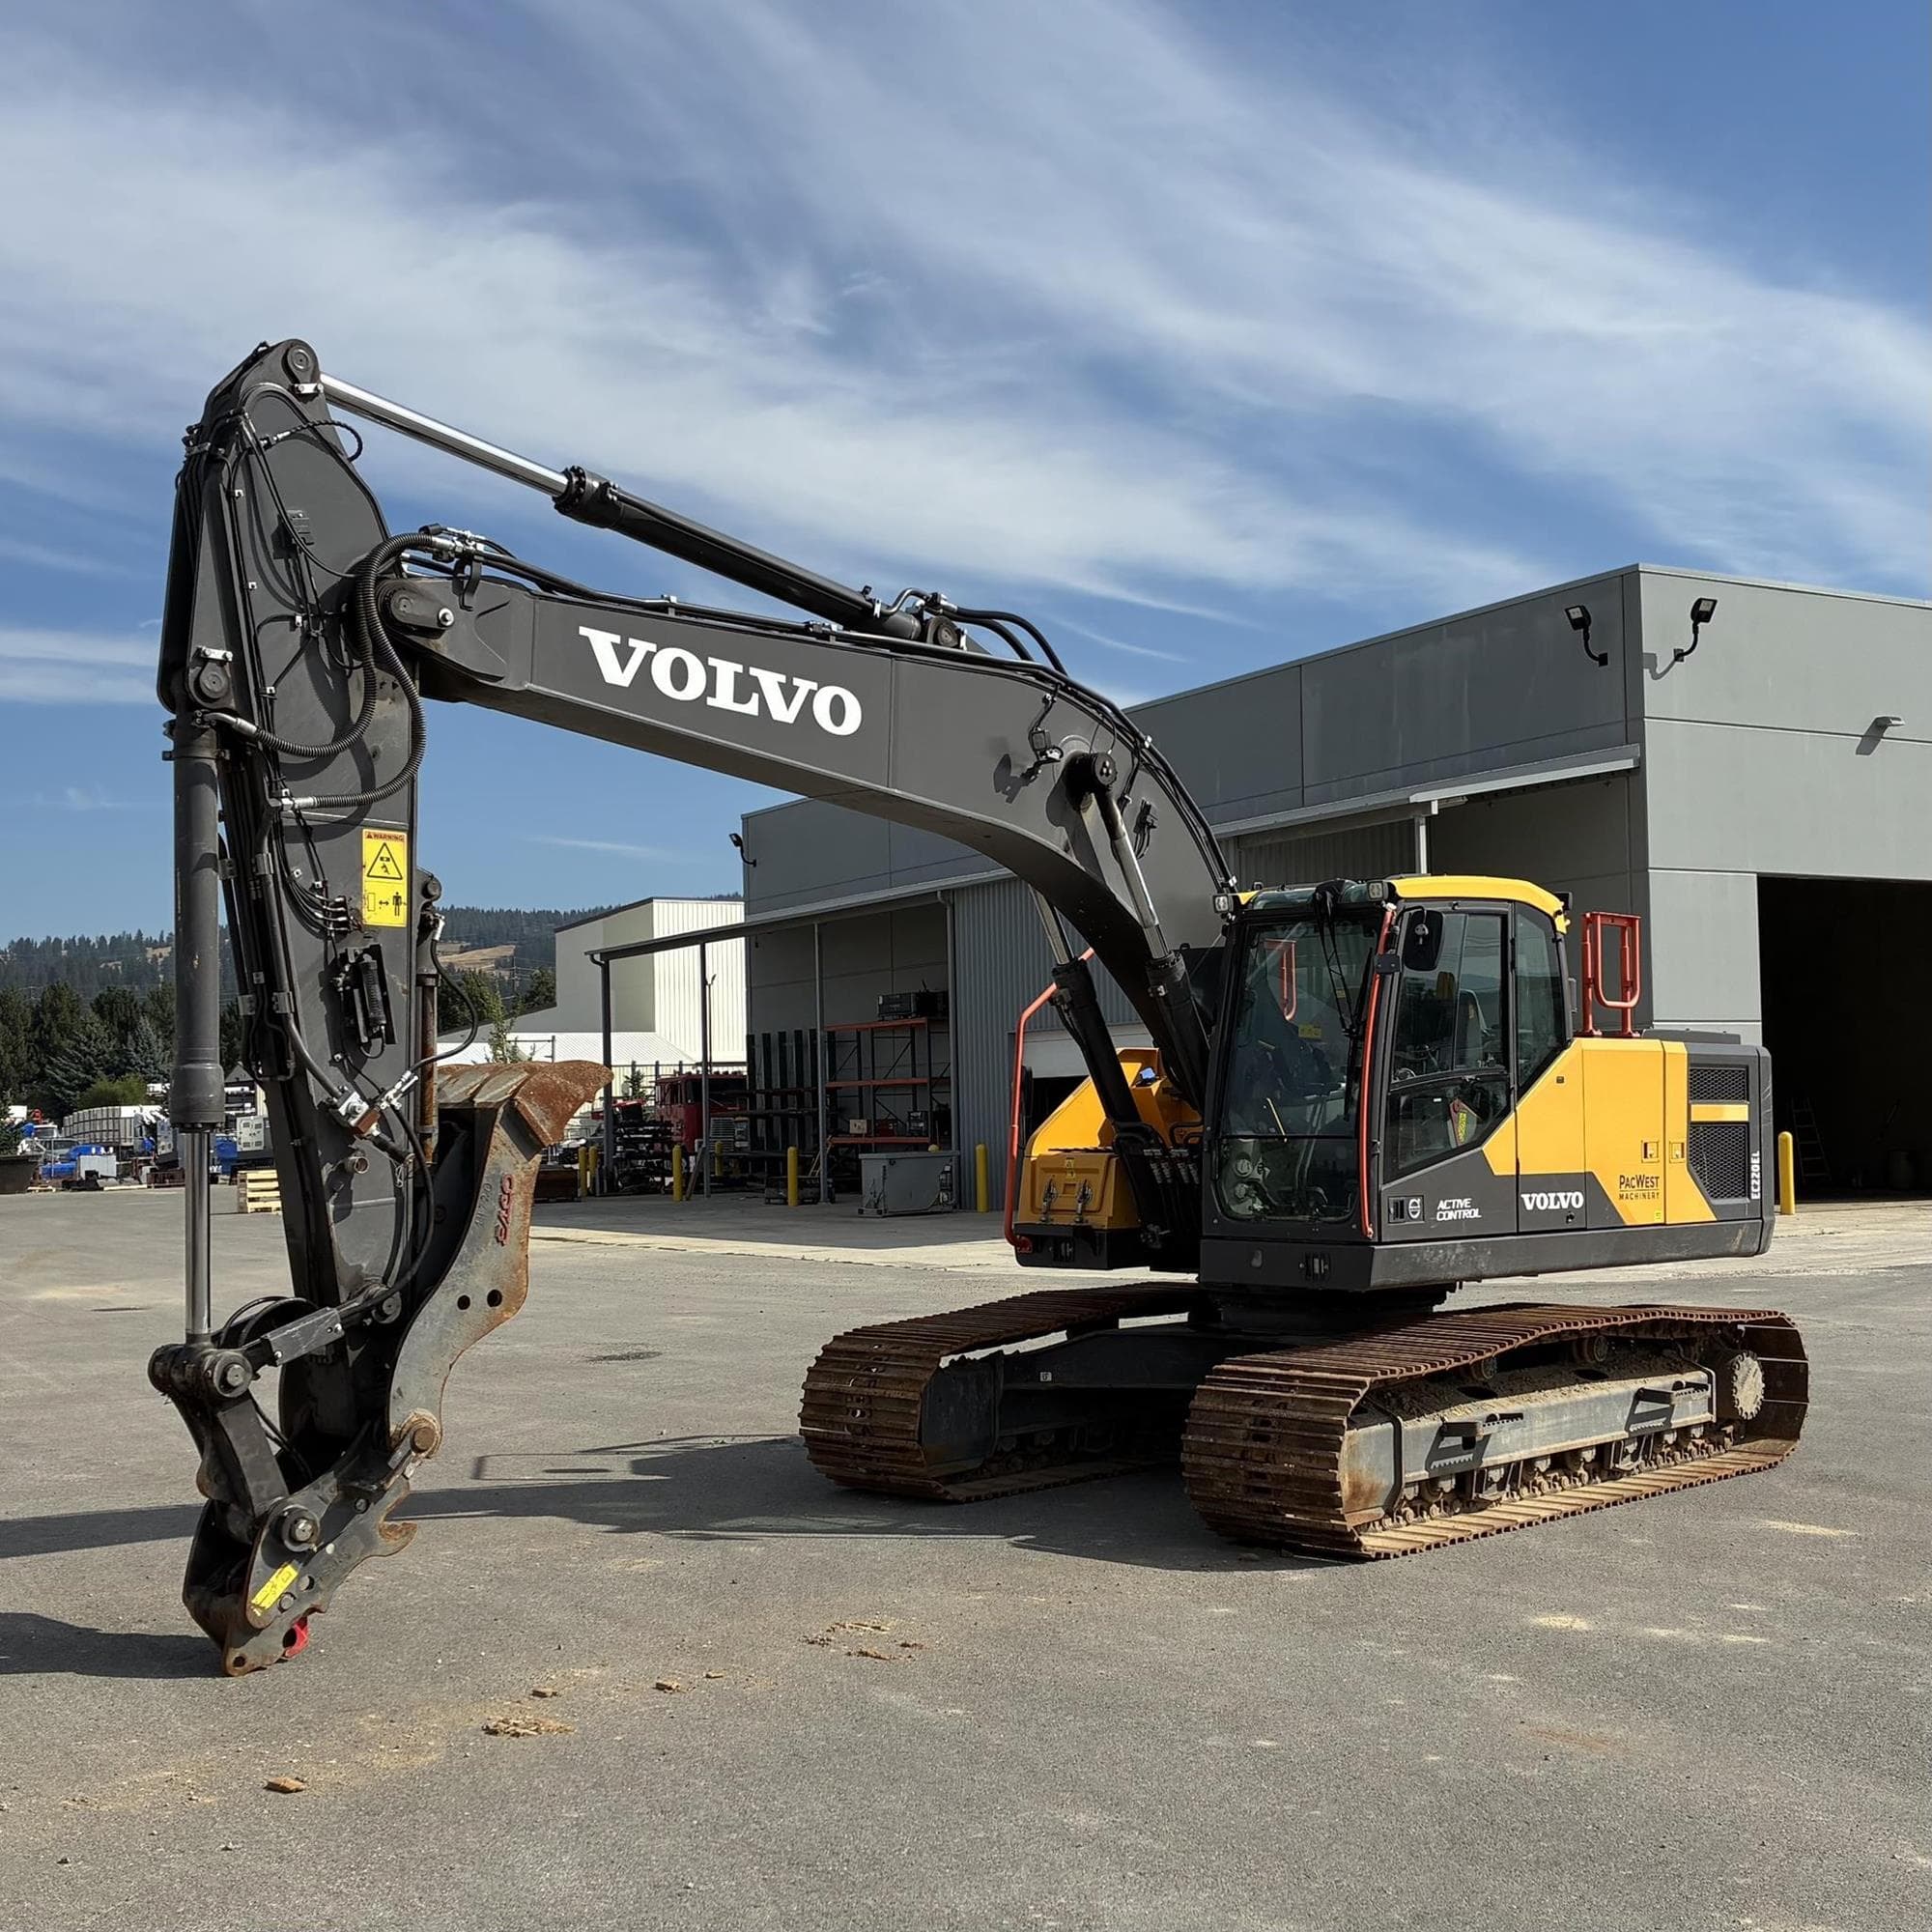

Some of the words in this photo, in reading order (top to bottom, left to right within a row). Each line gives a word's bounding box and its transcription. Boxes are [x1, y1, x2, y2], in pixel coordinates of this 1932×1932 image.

[579, 625, 863, 736] VOLVO
[1750, 1151, 1761, 1200] EC220EL
[1436, 1198, 1472, 1210] ACTIVE
[1520, 1191, 1584, 1210] VOLVO
[1619, 1192, 1660, 1201] MACHINERY
[1436, 1208, 1482, 1221] CONTROL
